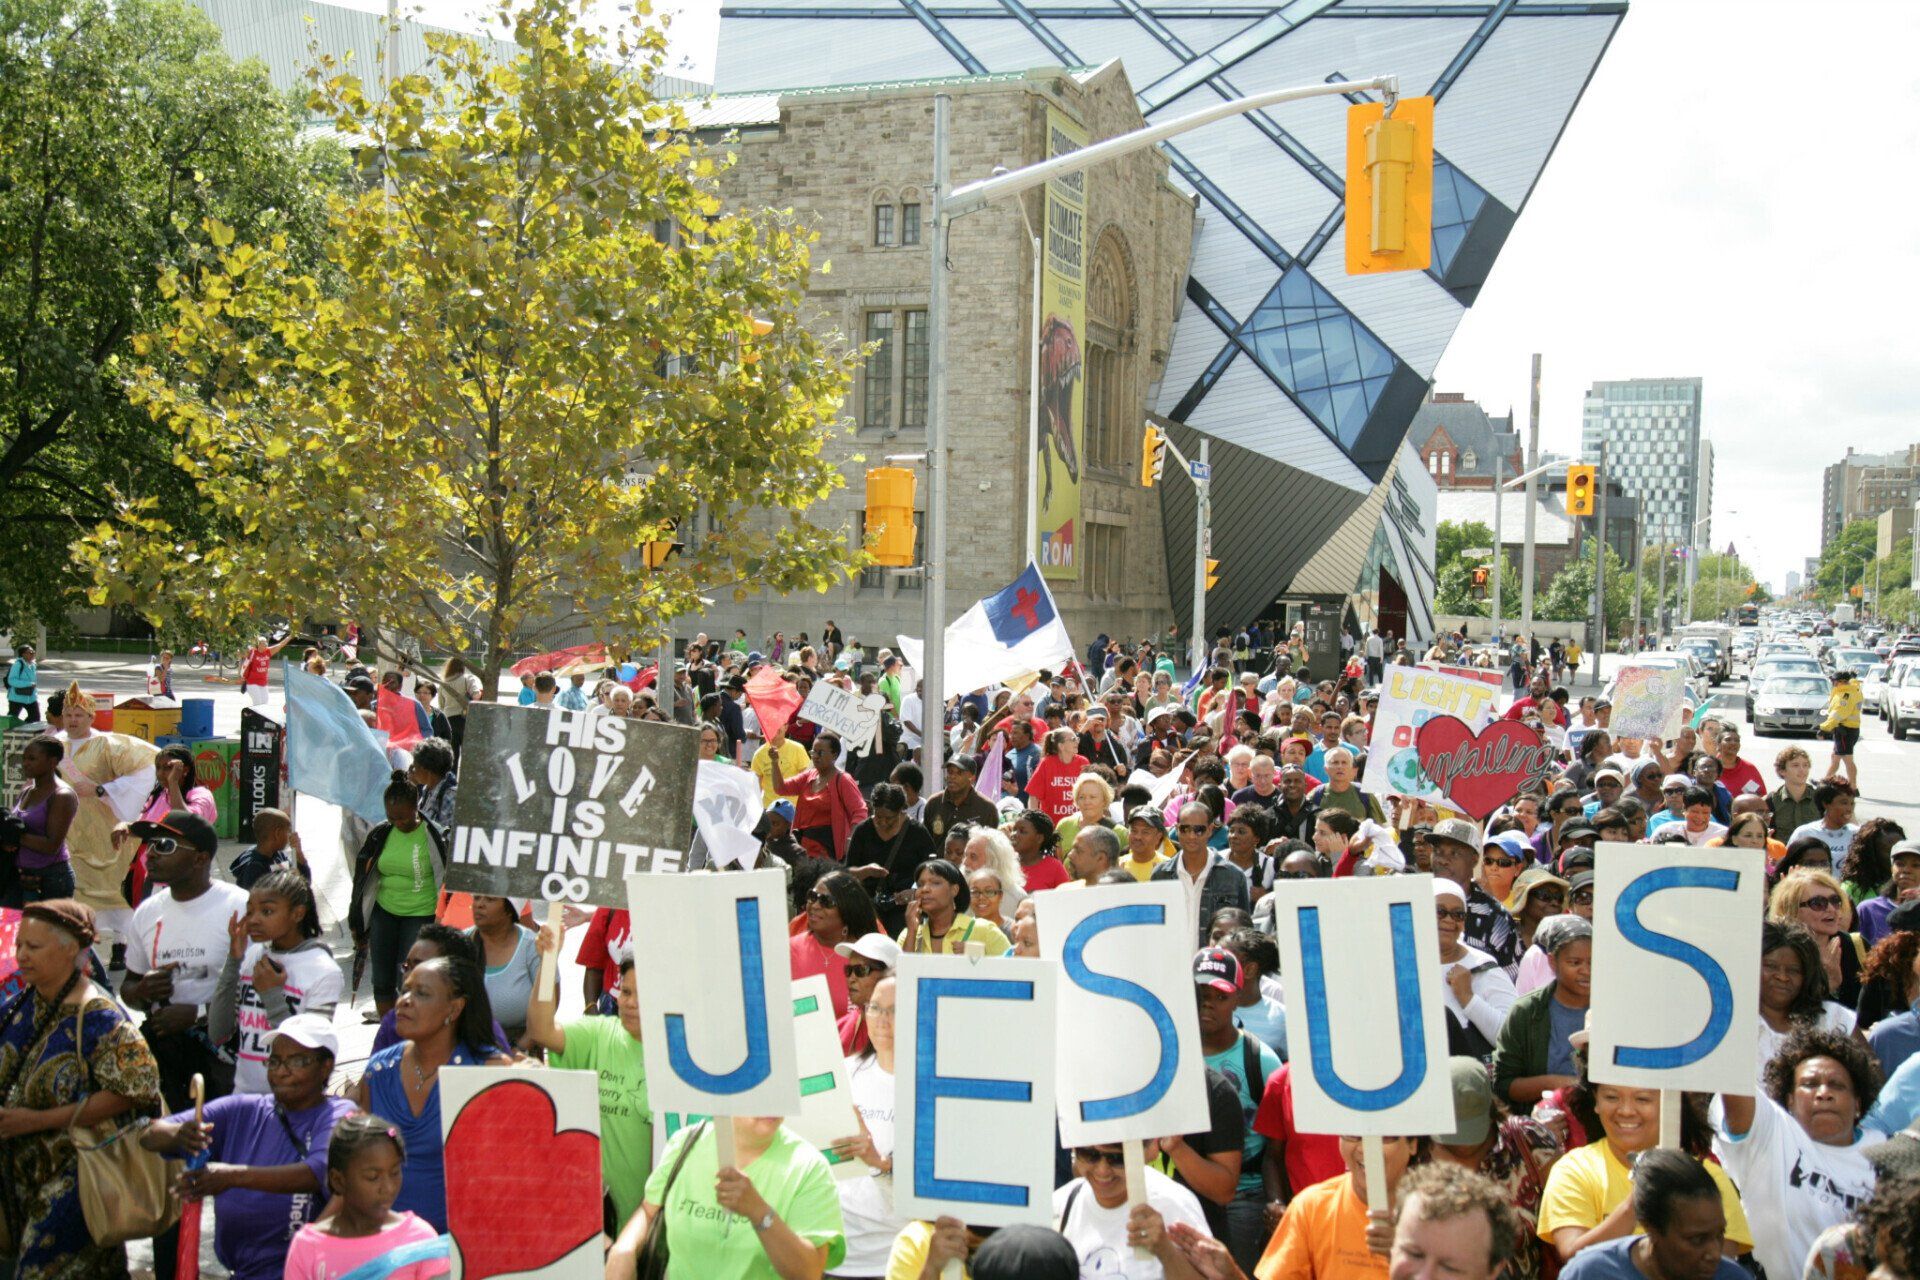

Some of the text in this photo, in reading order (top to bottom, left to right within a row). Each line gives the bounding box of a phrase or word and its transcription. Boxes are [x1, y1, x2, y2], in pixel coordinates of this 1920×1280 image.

[1050, 196, 1082, 243] ULTIMATE
[1041, 541, 1073, 567] ROM
[825, 688, 851, 712] I'M
[1390, 671, 1492, 721] LIGHT
[546, 708, 627, 754] HIS
[802, 701, 860, 736] FORGIVEN
[506, 746, 656, 818] LOVE
[1416, 733, 1557, 799] unfailing
[550, 796, 606, 839] IS
[452, 825, 683, 881] INFINITE
[1197, 961, 1227, 973] JESUS
[600, 1069, 625, 1085] Don't
